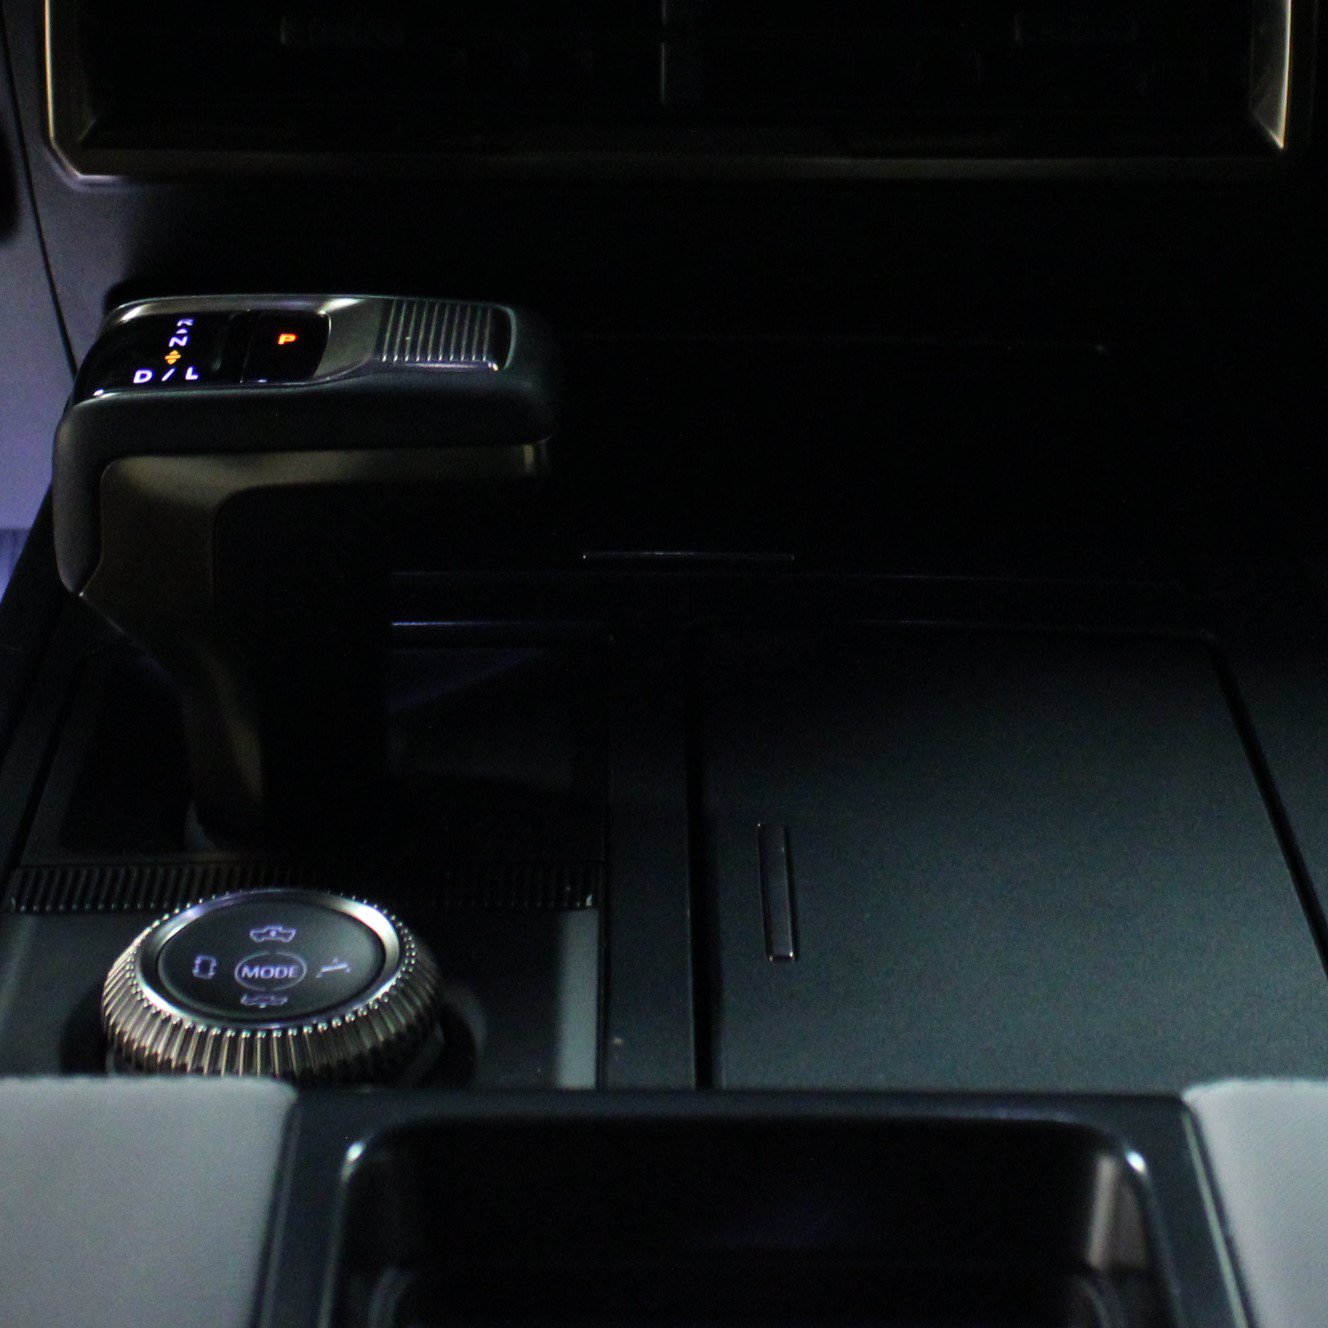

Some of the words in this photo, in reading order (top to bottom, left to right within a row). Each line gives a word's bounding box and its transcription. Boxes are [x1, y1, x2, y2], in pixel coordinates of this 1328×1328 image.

[168, 336, 188, 347] N
[277, 333, 297, 345] P
[241, 965, 299, 979] MODE
